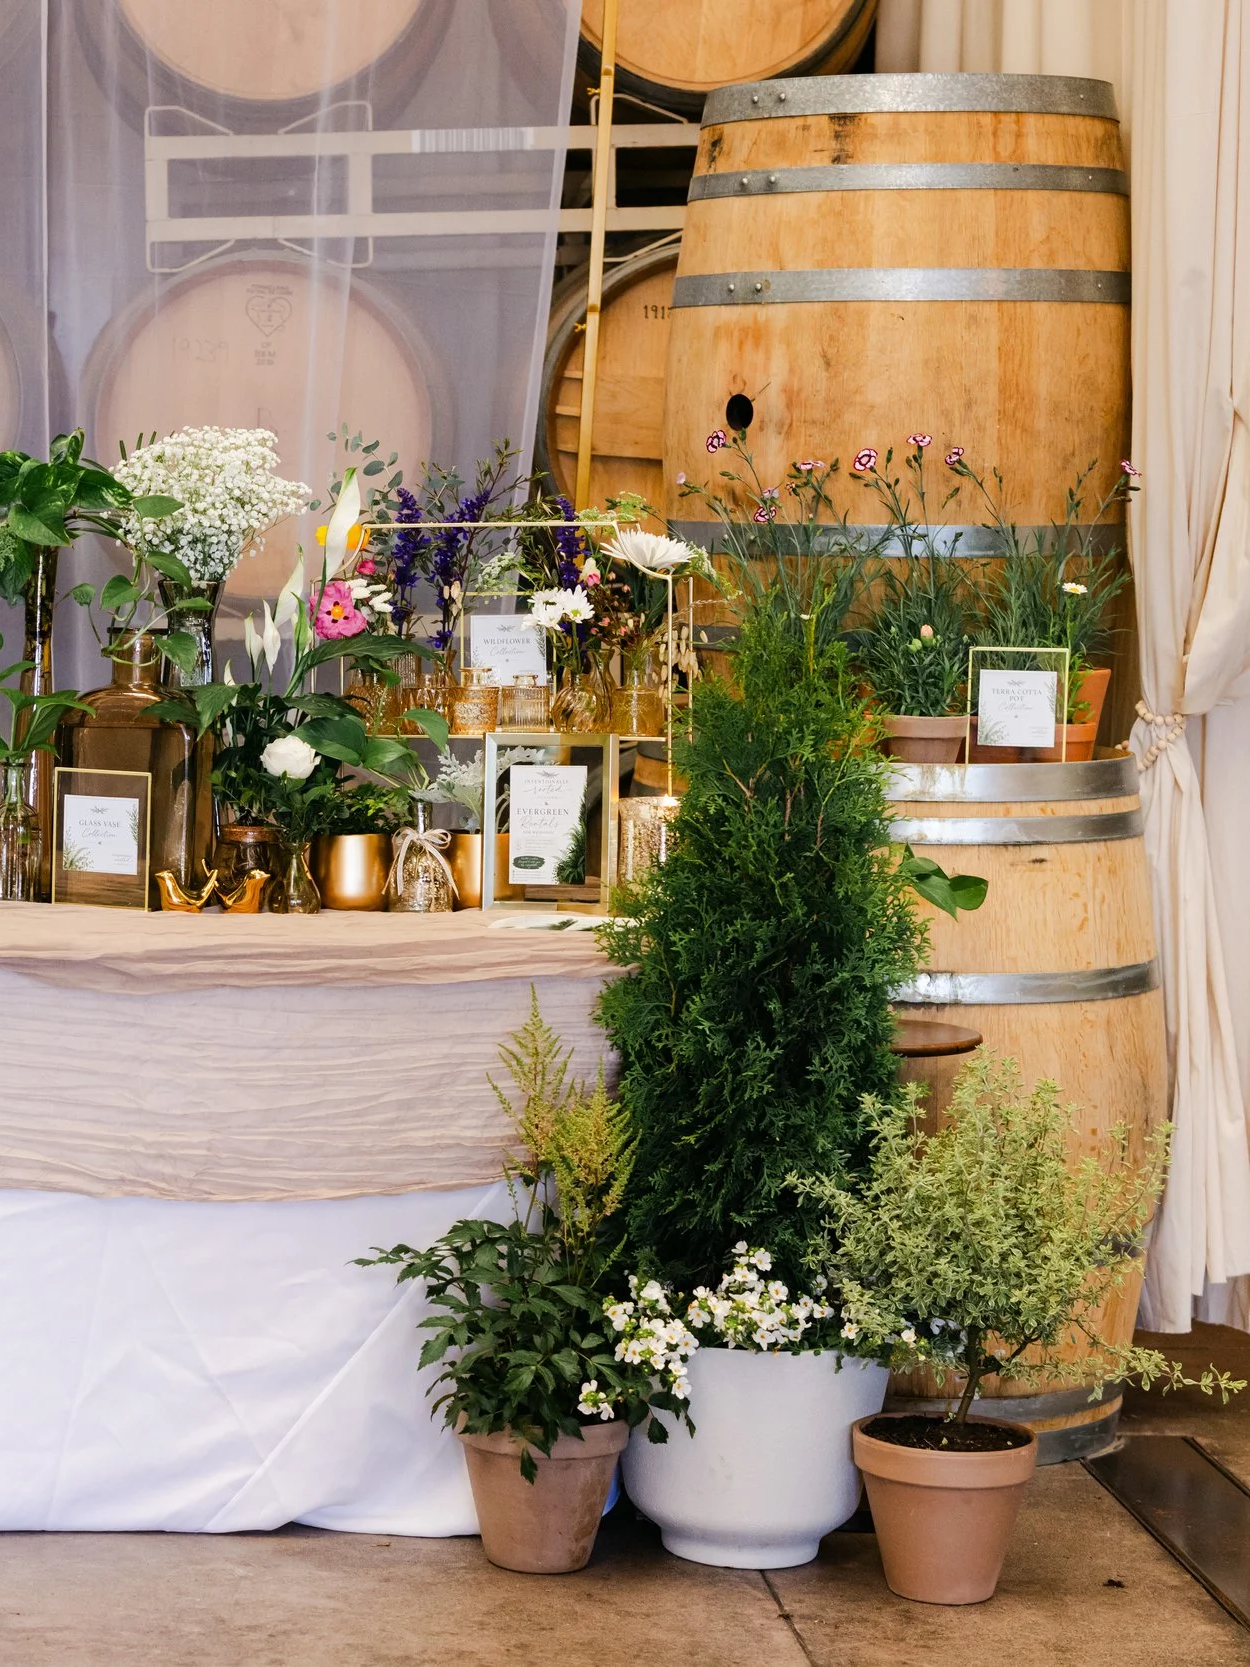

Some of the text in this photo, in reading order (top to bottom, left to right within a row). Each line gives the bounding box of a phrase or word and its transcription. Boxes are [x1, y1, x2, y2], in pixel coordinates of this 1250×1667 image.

[643, 304, 671, 319] 191
[483, 637, 530, 645] WILDFLOWER
[1017, 688, 1042, 696] COTTA
[516, 807, 569, 816] EVERGREEN
[78, 819, 120, 828] GLASS VASE
